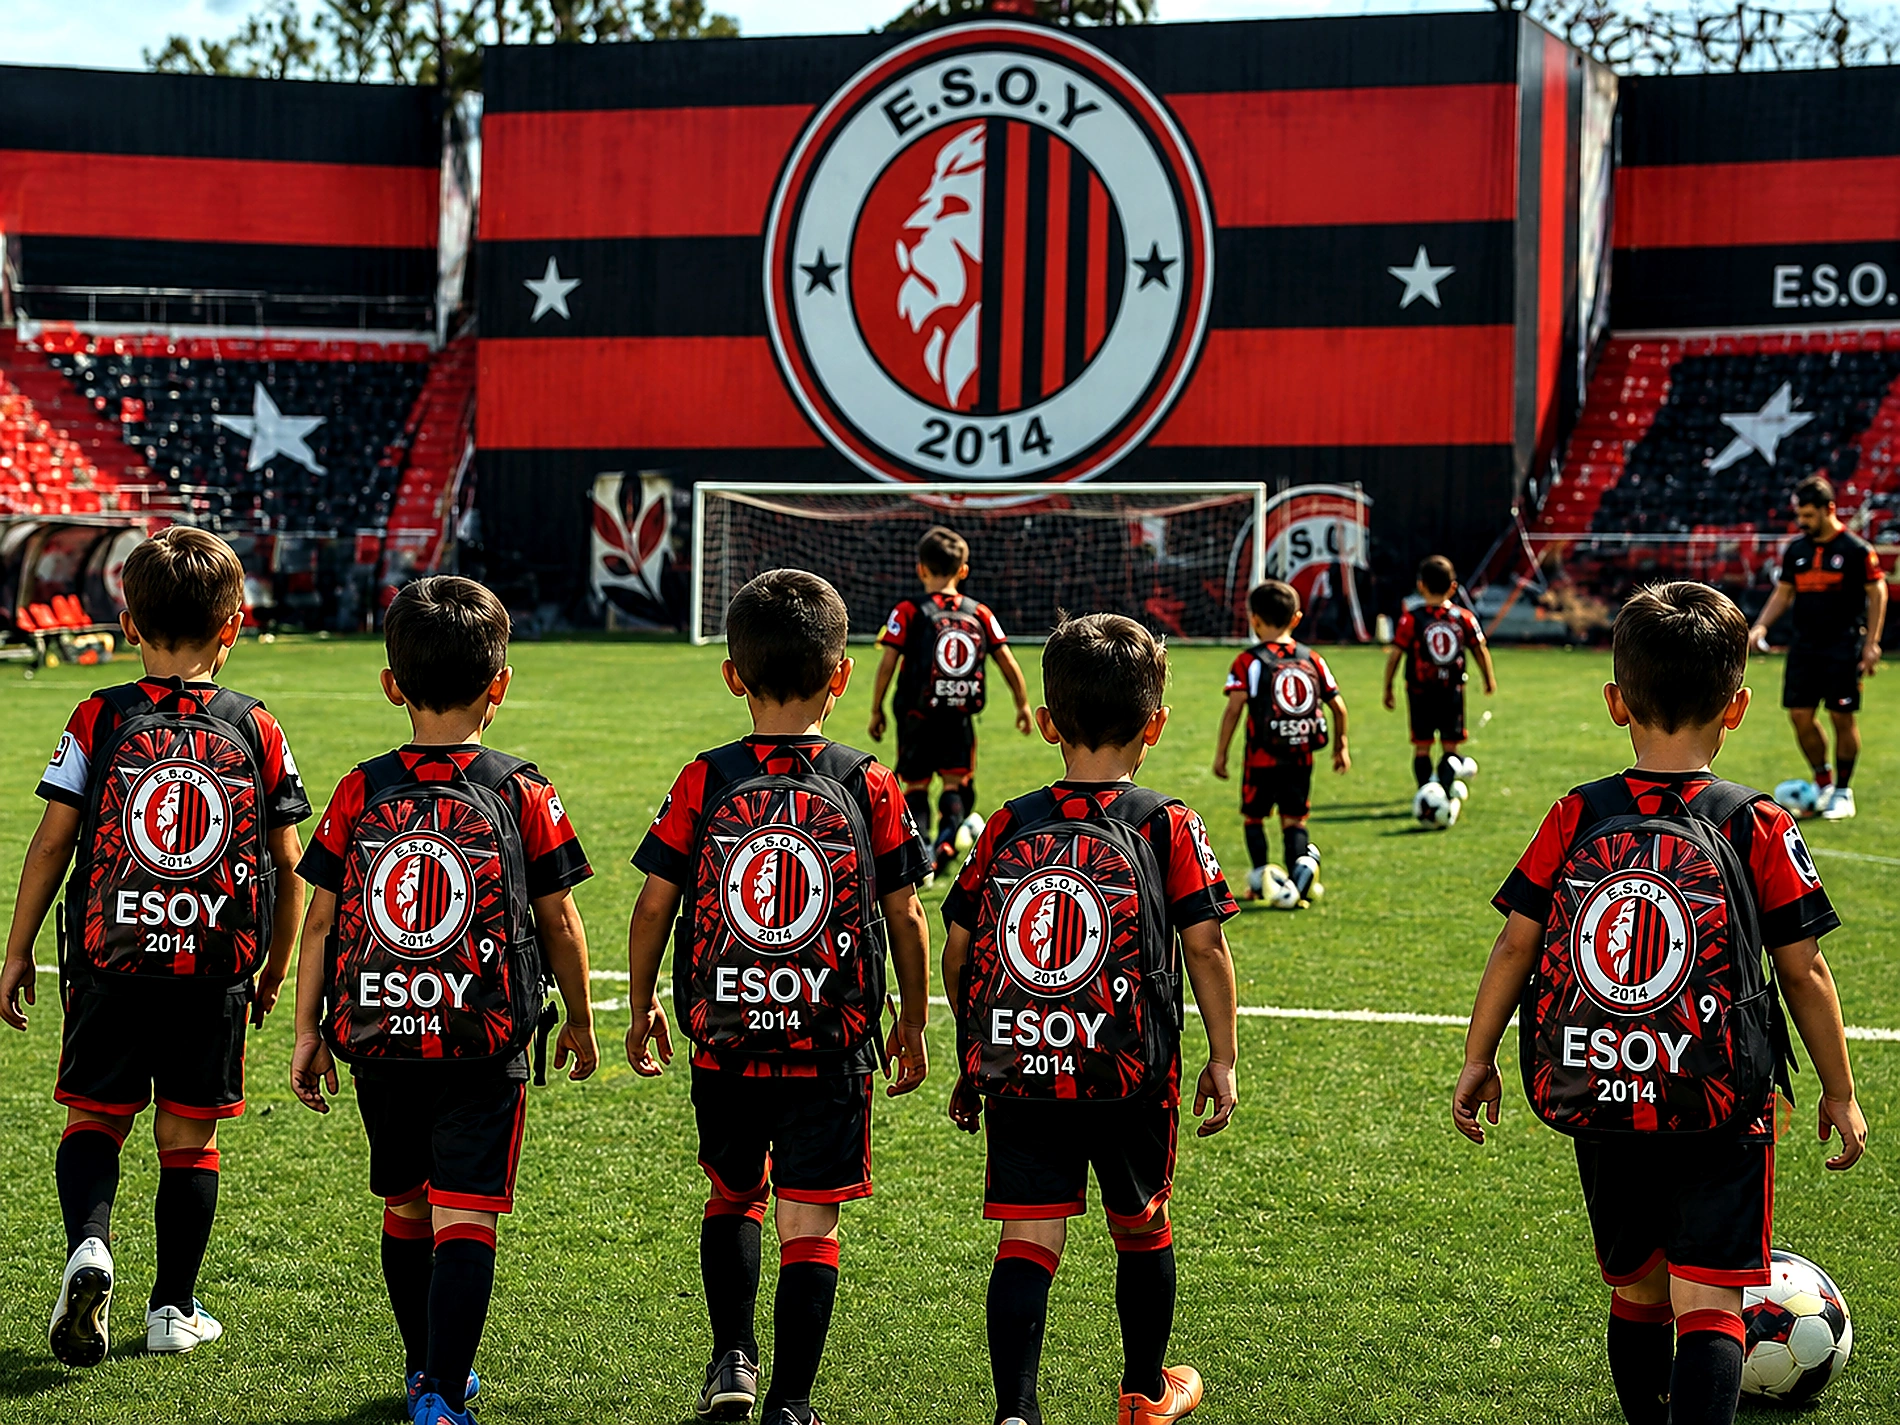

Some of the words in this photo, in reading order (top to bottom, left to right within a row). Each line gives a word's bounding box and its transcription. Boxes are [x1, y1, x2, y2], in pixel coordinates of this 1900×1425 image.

[881, 66, 1101, 136] E.S.O.Y
[1773, 262, 1899, 308] E.S.O.
[917, 416, 1053, 466] 2014
[935, 680, 979, 697] ESOY
[158, 854, 193, 868] 2014
[234, 863, 248, 885] 9
[115, 890, 228, 927] ESOY
[145, 933, 196, 953] 2014
[399, 932, 435, 947] 2014
[757, 929, 793, 942] 2014
[837, 932, 851, 956] 9
[479, 938, 495, 962] 9
[716, 967, 830, 1003] ESOY
[1032, 970, 1068, 984] 2014
[1113, 976, 1128, 1002] 9
[359, 972, 473, 1008] ESOY
[1609, 985, 1649, 1002] 2014
[748, 1010, 801, 1030] 2014
[1699, 994, 1717, 1023] 9
[389, 1015, 441, 1035] 2014
[991, 1008, 1107, 1048] ESOY
[1562, 1026, 1692, 1073] ESOY
[1022, 1054, 1075, 1075] 2014
[1597, 1079, 1656, 1103] 2014
